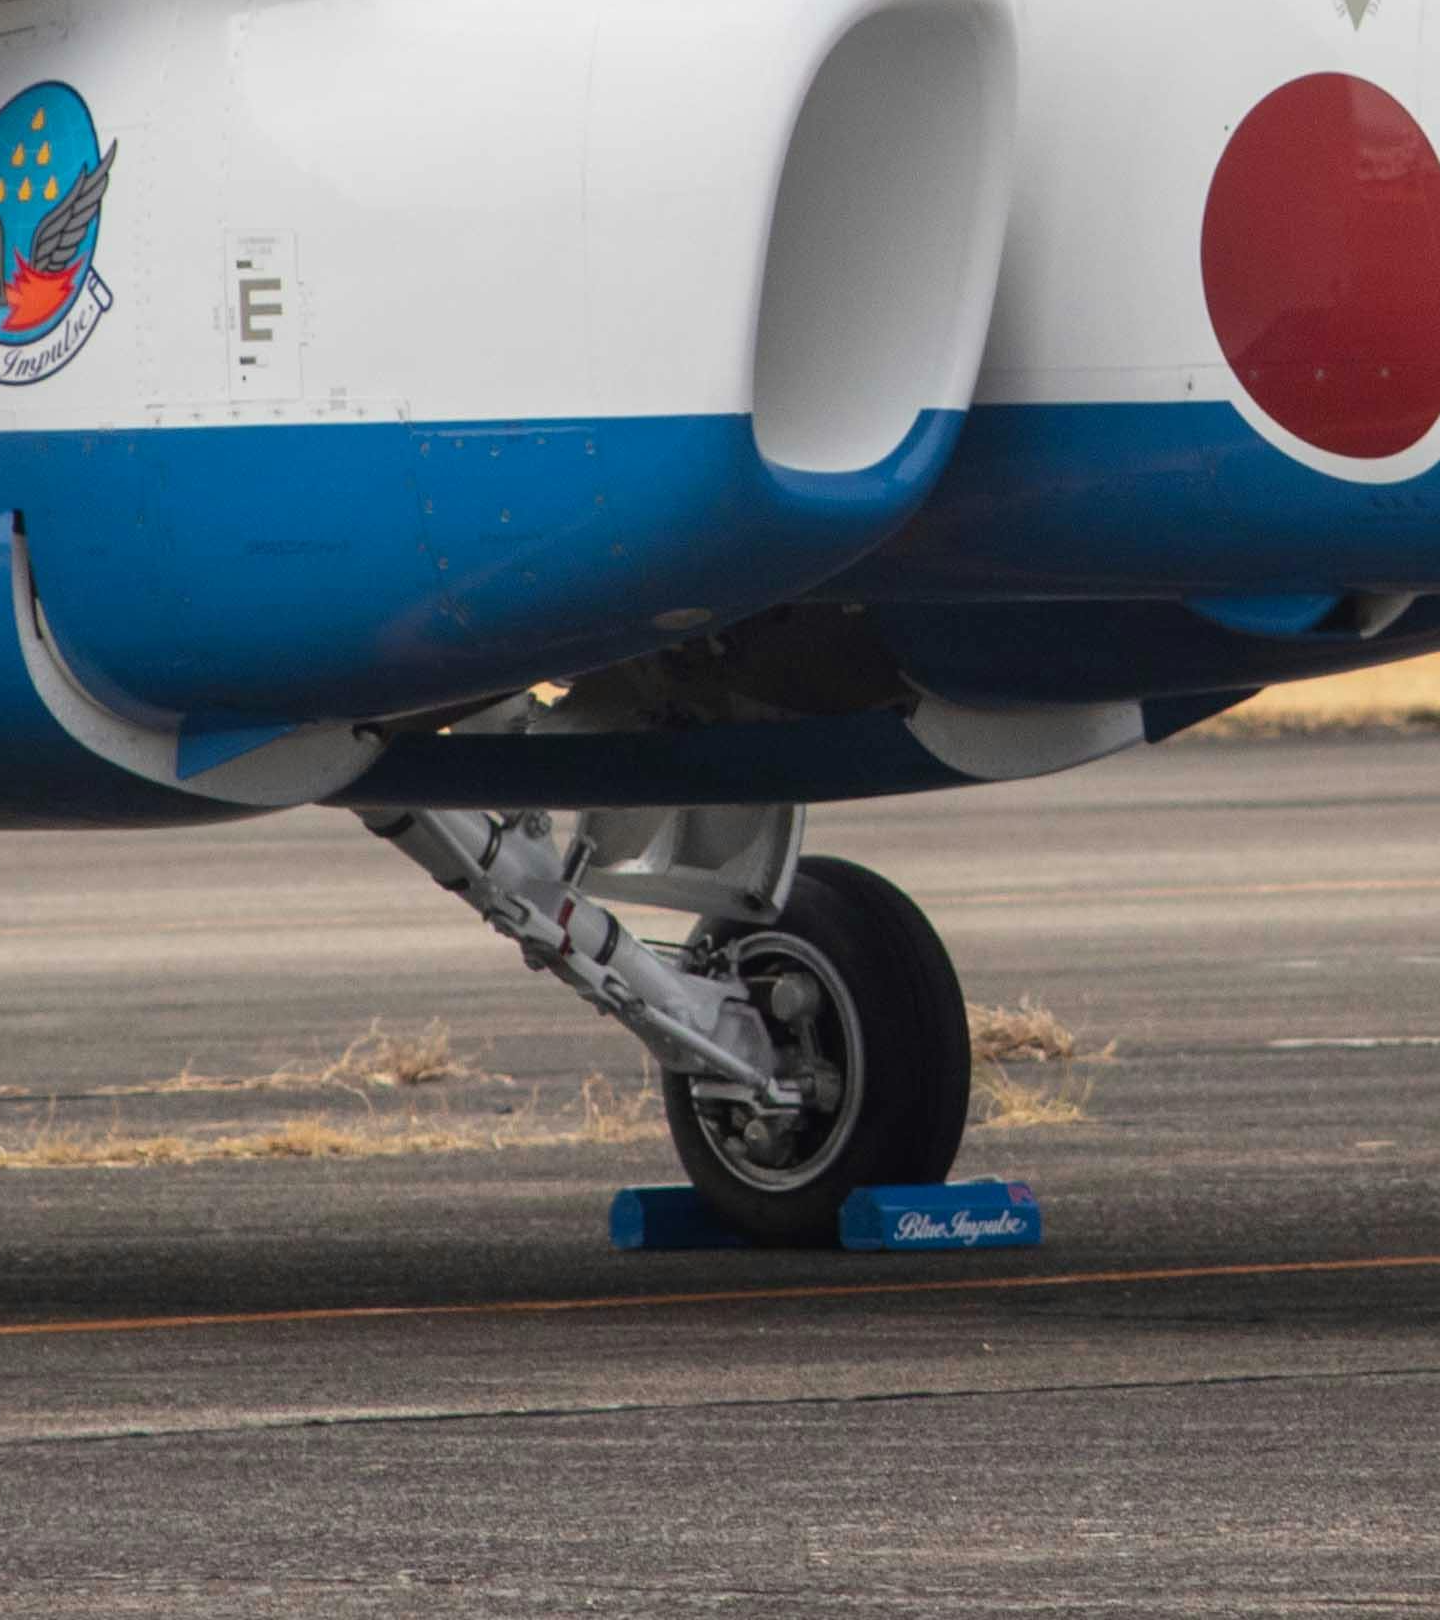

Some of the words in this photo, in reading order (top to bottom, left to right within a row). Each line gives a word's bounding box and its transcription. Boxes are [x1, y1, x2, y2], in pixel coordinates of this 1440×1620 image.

[239, 278, 283, 343] E
[893, 1210, 946, 1241] Blue
[944, 1209, 1028, 1247] Impulse
